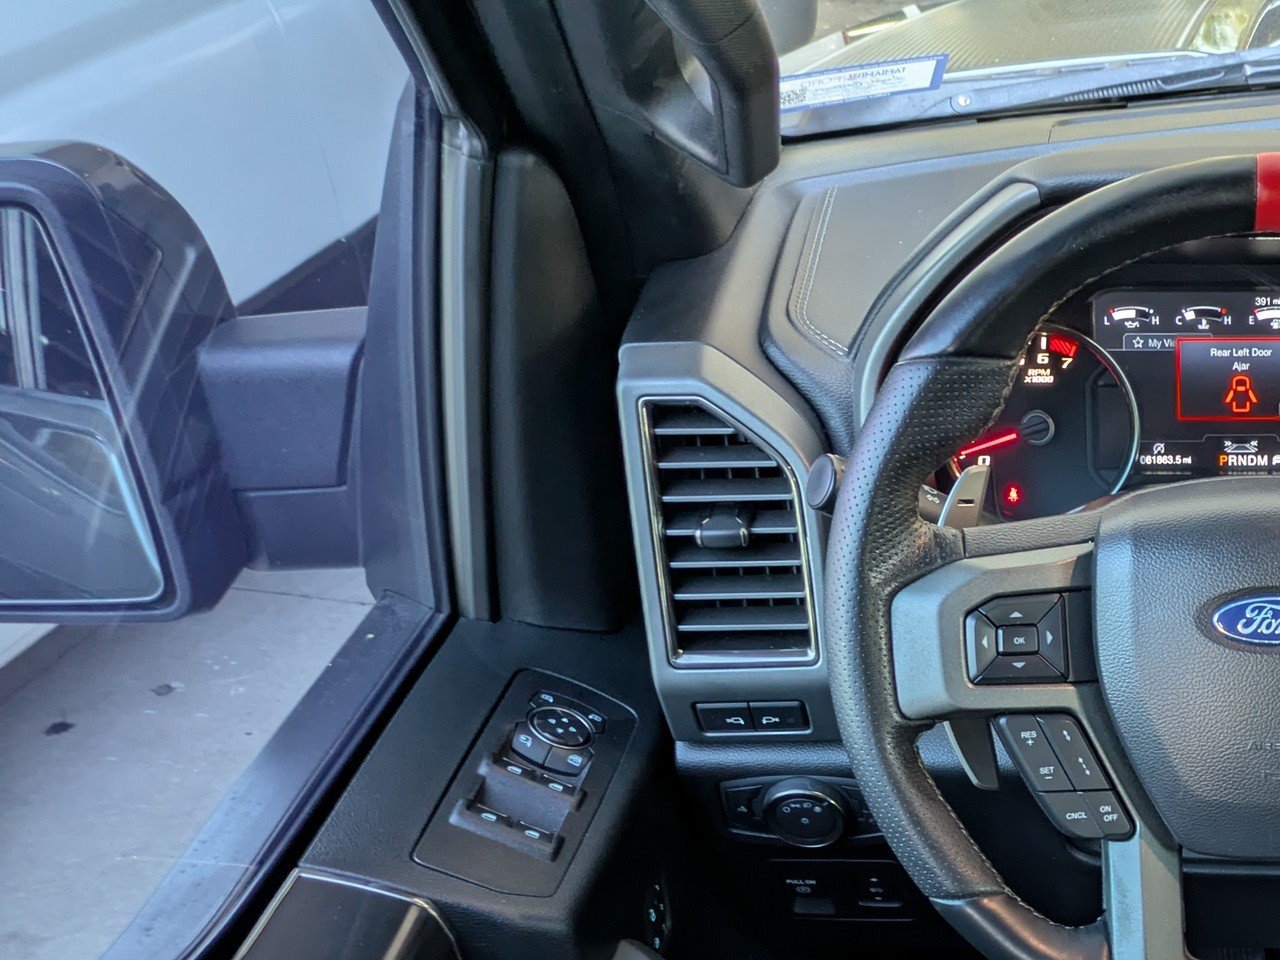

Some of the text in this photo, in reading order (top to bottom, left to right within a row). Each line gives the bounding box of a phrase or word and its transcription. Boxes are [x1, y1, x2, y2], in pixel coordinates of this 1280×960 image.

[1255, 297, 1271, 306] 391
[1272, 297, 1280, 305] mi
[1103, 316, 1110, 325] L
[1152, 316, 1160, 325] H
[1175, 316, 1183, 325] C
[1224, 316, 1232, 325] H
[1249, 316, 1255, 325] E
[1148, 339, 1162, 349] My
[1210, 348, 1272, 357] Rear Left Door
[1036, 353, 1049, 364] 6
[1061, 357, 1073, 369] 7
[1232, 362, 1250, 371] Ajar
[1027, 368, 1051, 376] RPM
[1140, 454, 1192, 465] 061863.5 mi
[1219, 454, 1268, 466] PRNDM
[1013, 637, 1026, 645] OK
[1020, 730, 1037, 740] RES
[1039, 766, 1055, 775] SET
[1100, 805, 1111, 813] ON
[1066, 811, 1088, 820] CNCL
[1103, 814, 1119, 822] OFF
